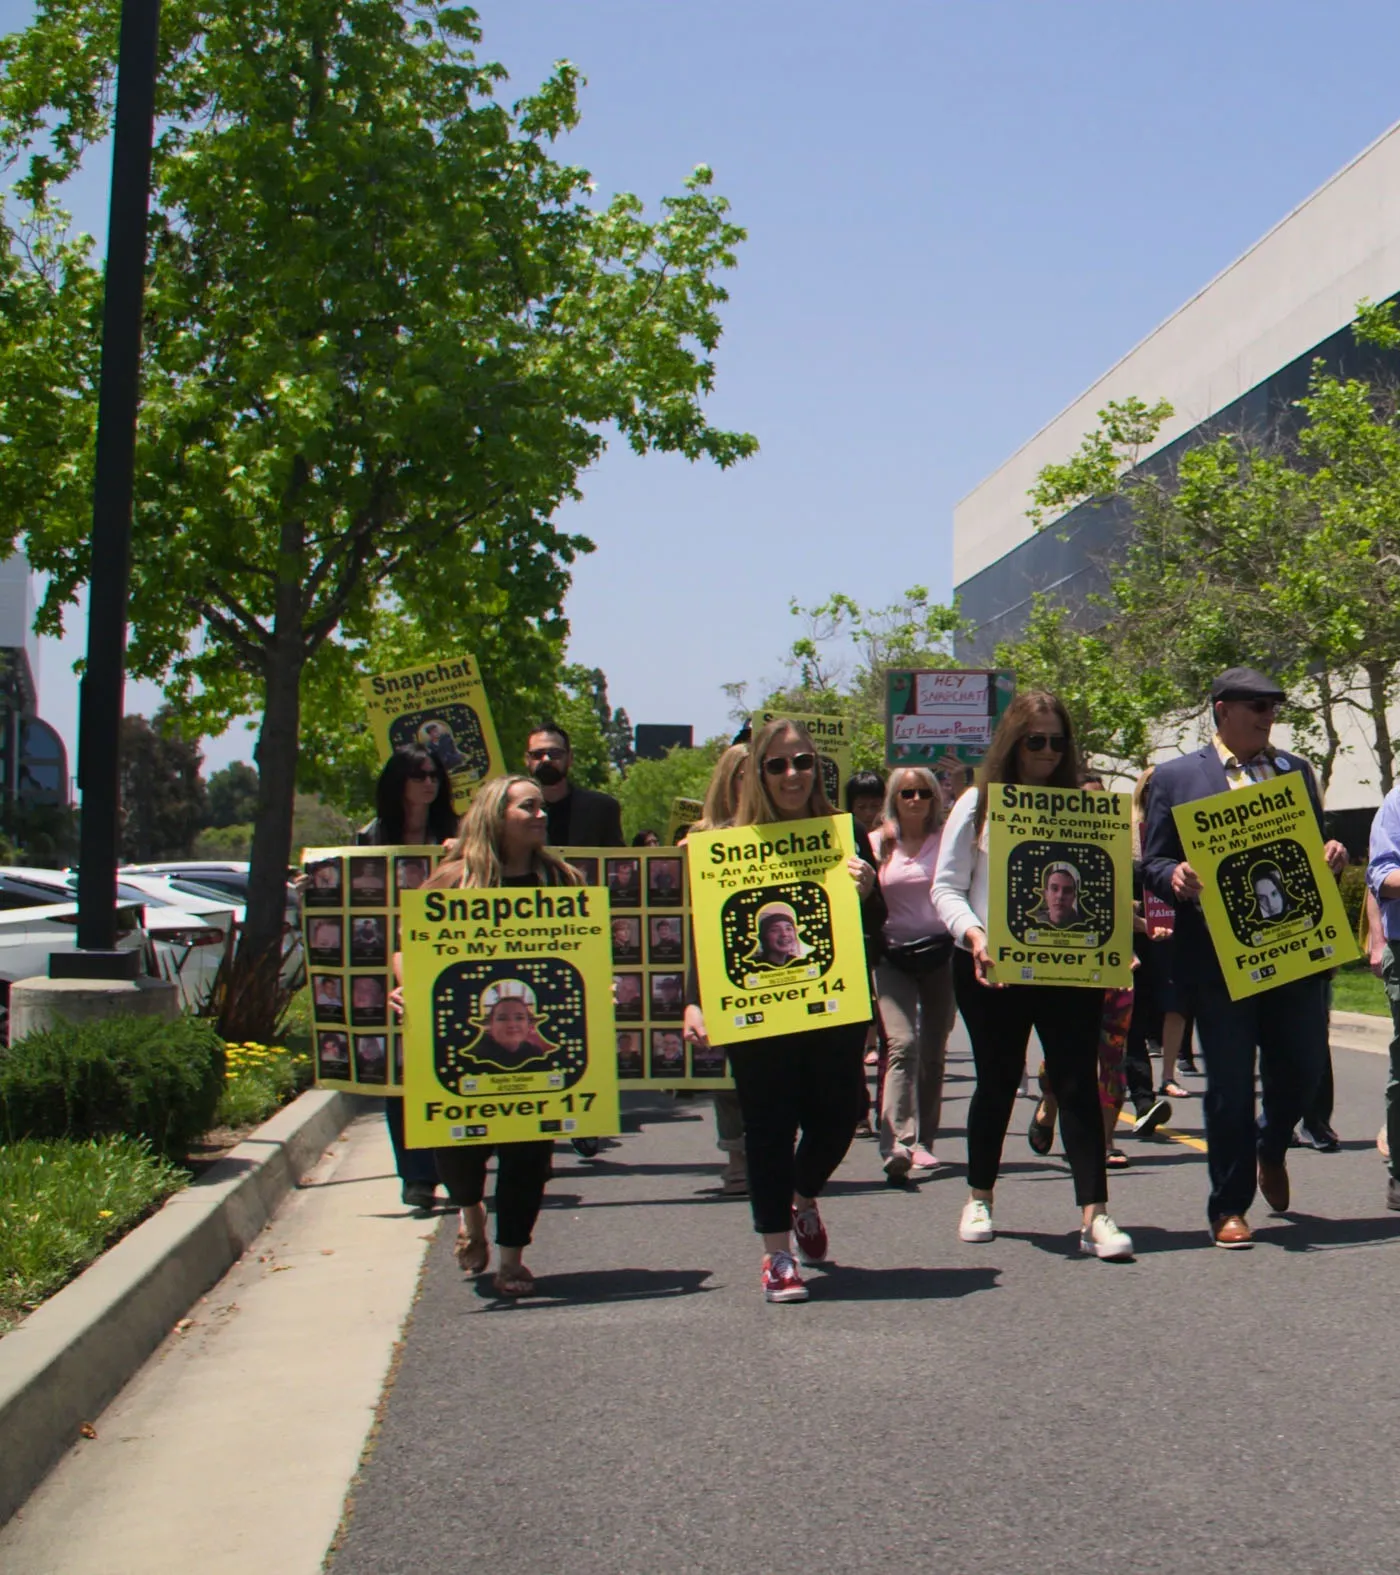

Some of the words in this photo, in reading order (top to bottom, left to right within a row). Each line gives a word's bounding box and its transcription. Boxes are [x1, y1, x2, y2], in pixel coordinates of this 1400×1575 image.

[372, 658, 473, 695] Snapchat
[934, 676, 966, 688] HEY
[384, 706, 399, 714] To
[403, 702, 421, 711] My
[425, 691, 470, 705] Murder
[385, 696, 402, 705] An
[1002, 784, 1120, 816] Snapchat
[1194, 785, 1296, 833] Snapchat
[991, 812, 1006, 822] Is
[1011, 813, 1032, 824] An
[1037, 815, 1130, 831] Accomplice
[1007, 825, 1026, 835] To
[1032, 827, 1054, 839] My
[1060, 828, 1116, 841] Murder
[1192, 840, 1205, 850] Is
[1209, 834, 1226, 844] An
[1231, 809, 1306, 838] Accomplice
[710, 829, 831, 864] Snapchat
[1208, 845, 1225, 855] To
[1229, 839, 1248, 849] My
[1252, 822, 1297, 843] Murder
[701, 871, 715, 880] Is
[721, 868, 741, 878] An
[748, 853, 844, 873] Accomplice
[717, 879, 736, 888] To
[743, 876, 765, 885] My
[770, 867, 828, 882] Murder
[424, 889, 590, 927] Snapchat
[410, 929, 430, 941] Is
[438, 928, 466, 940] An
[474, 924, 602, 938] Accomplice
[433, 944, 459, 956] To
[467, 942, 498, 956] My
[505, 940, 582, 953] Murder
[998, 947, 1087, 965] Forever
[1095, 952, 1121, 967] 16
[1235, 936, 1308, 970] Forever
[1314, 925, 1337, 943] 16
[720, 986, 810, 1011] Forever
[818, 978, 846, 995] 14
[425, 1100, 550, 1122] Forever
[561, 1093, 597, 1113] 17
